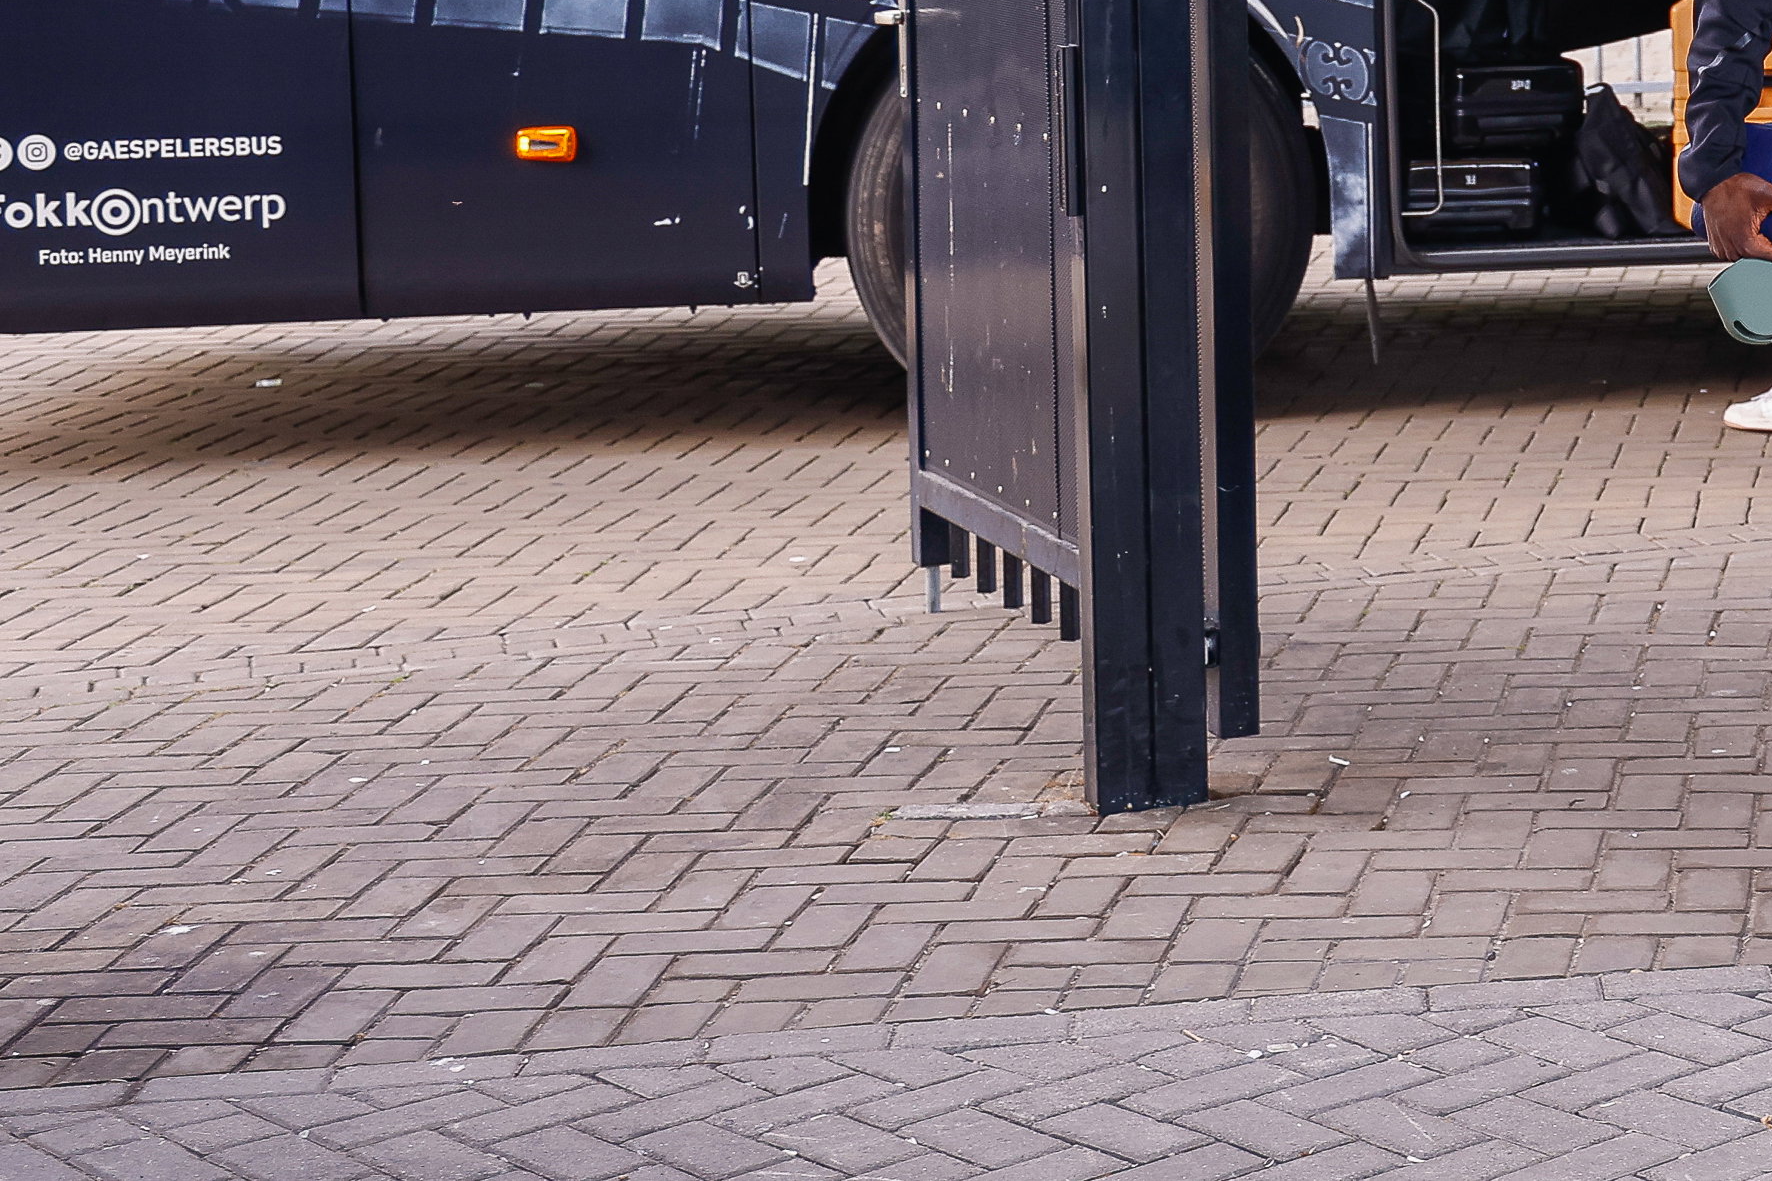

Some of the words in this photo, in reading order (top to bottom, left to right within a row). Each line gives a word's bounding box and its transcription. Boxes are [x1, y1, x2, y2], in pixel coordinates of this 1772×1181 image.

[63, 135, 283, 161] @GAESPELERSBUS
[39, 248, 84, 265] Foto:
[88, 246, 145, 265] Henny
[149, 243, 231, 264] Meyerink
